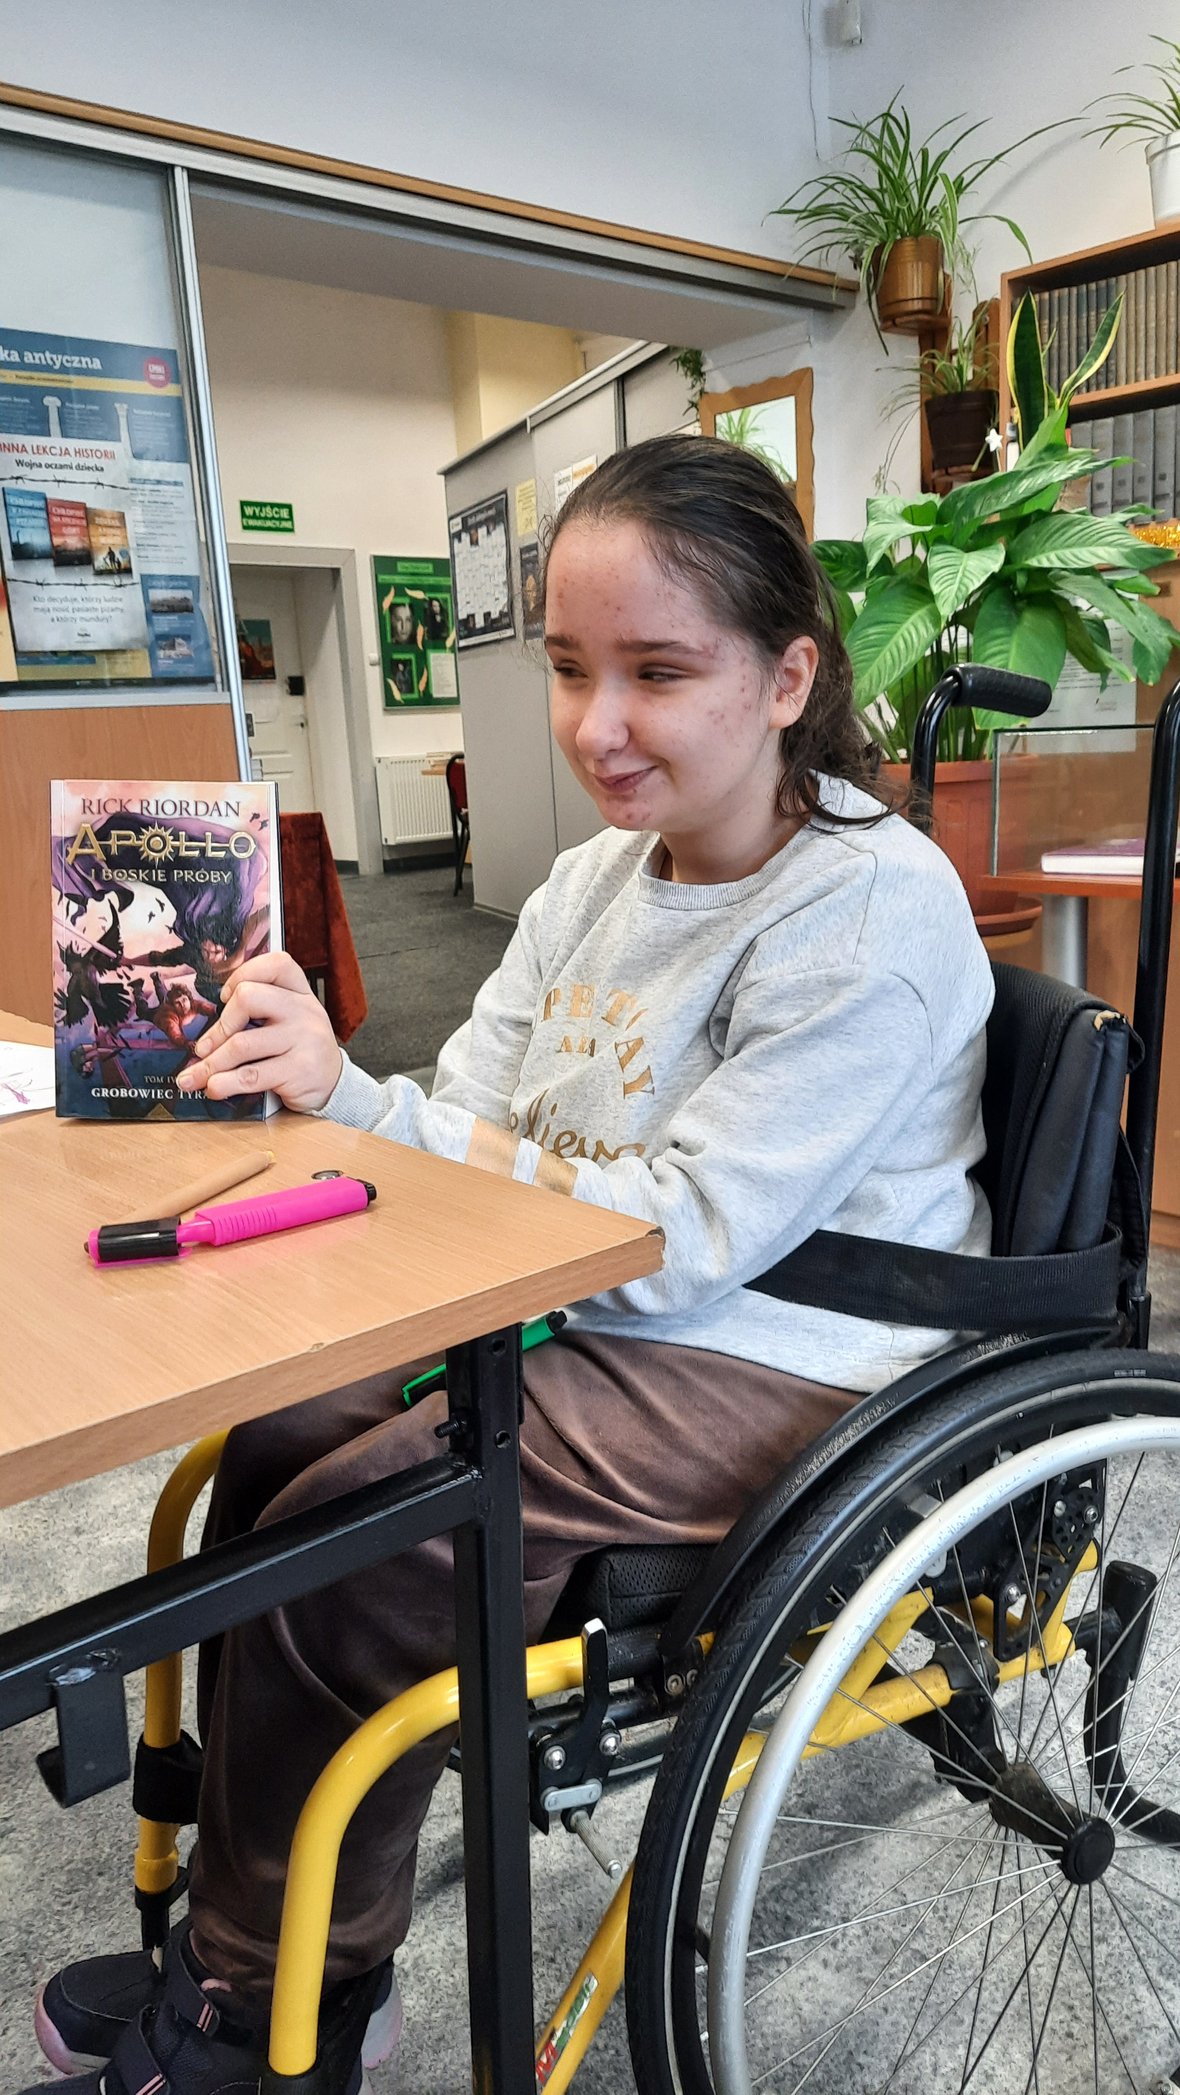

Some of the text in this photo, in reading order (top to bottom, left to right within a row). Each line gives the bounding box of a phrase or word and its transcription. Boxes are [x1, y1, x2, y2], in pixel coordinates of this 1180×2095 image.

[24, 350, 103, 370] antyczna
[31, 444, 71, 457] LEKCJA
[74, 447, 116, 460] HISTORII
[15, 459, 104, 472] Wojna oczami dziecka
[243, 504, 291, 519] WYJŚCIE
[81, 798, 242, 818] RICK RIORDAN
[65, 821, 257, 867] APOLLO
[102, 868, 167, 883] BOSKIE
[173, 867, 233, 884] PRÓBY
[144, 1075, 164, 1084] TOM
[91, 1087, 174, 1100] GROBOWIEC
